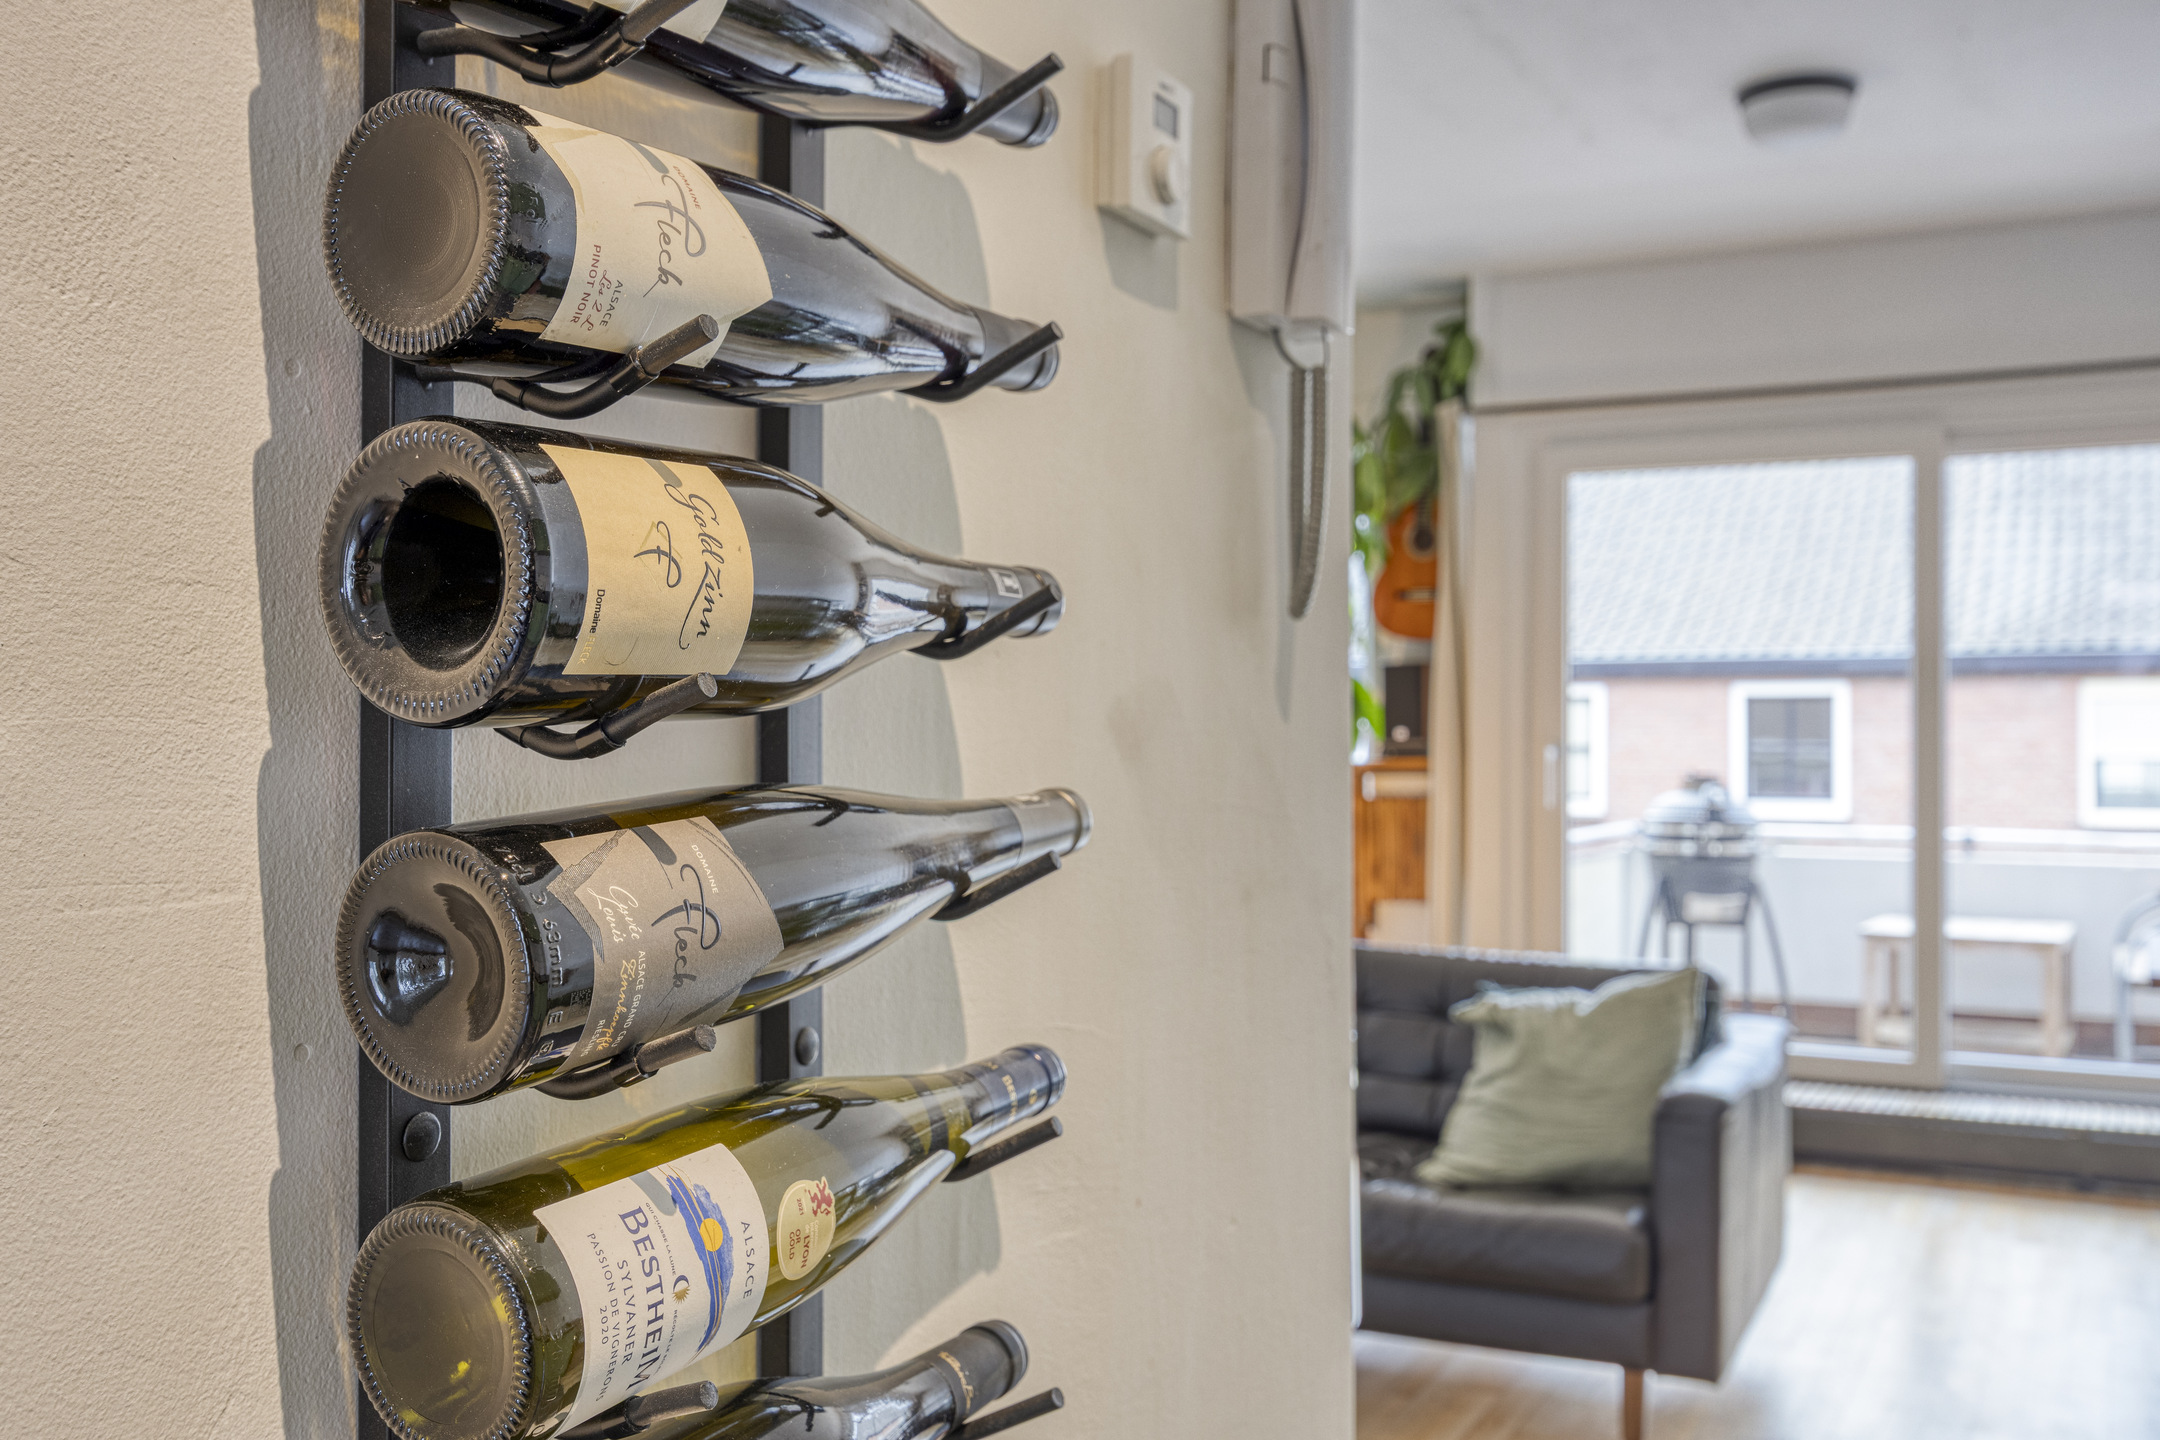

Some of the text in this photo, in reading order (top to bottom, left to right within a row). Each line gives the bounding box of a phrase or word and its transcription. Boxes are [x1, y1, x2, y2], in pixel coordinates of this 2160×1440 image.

[672, 165, 702, 210] DOMAINE
[634, 174, 706, 298] Fleck
[570, 244, 602, 324] PINOT NOIR
[592, 299, 603, 313] 2
[599, 280, 624, 328] ALSACE
[580, 313, 595, 332] L
[577, 589, 606, 665] Domaine FLECK
[691, 844, 719, 894] DOMAINE
[587, 887, 625, 943] Louis
[651, 863, 722, 1007] Fleck
[542, 918, 564, 987] 63mm
[595, 959, 637, 1052] Zinnkoepfle
[611, 950, 646, 1048] ALSACE GRAND CRU
[580, 1018, 606, 1058] RIESLING
[645, 1202, 677, 1277] QUI CHASSE LA LUNE
[795, 1228, 802, 1245] OR
[796, 1197, 805, 1216] 2021
[740, 1220, 756, 1300] ALSACE
[800, 1234, 810, 1269] LYON
[587, 1232, 621, 1402] PASSION DE VIGNERONS
[599, 1305, 610, 1345] 2020
[616, 1259, 637, 1365] SYLVANER
[618, 1205, 665, 1392] BESTHEIM
